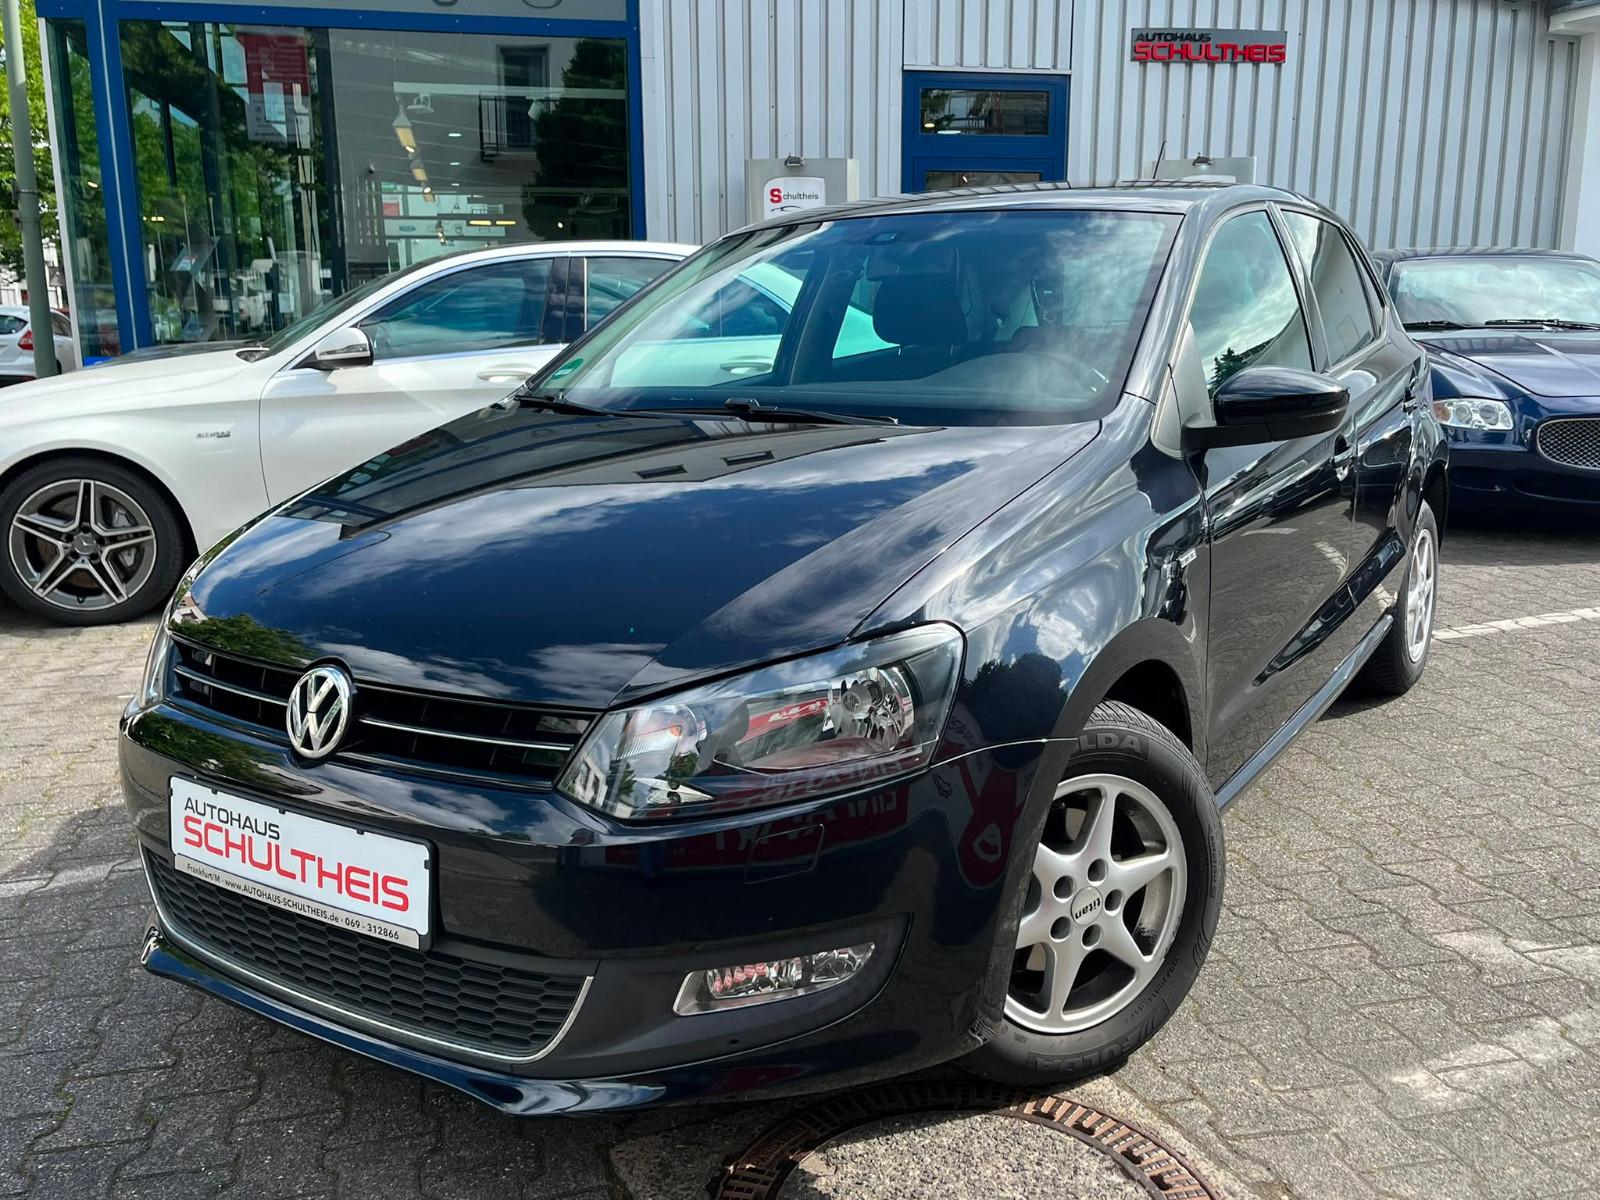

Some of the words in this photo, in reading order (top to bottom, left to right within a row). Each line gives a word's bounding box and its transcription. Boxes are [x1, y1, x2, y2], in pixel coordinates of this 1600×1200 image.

[1135, 32, 1212, 43] AUTOHAUS
[1134, 41, 1286, 62] SCHULTHEIS
[769, 187, 819, 204] Schultheis
[1079, 732, 1142, 754] LDA
[184, 797, 280, 840] AUTOHAUS
[184, 815, 409, 912] SCHULTHEIS
[225, 880, 339, 923] www.AUTOHAUS-SCHULTHEIS.de
[345, 917, 361, 929] 069
[367, 923, 400, 940] 312866
[1075, 897, 1101, 919] titan
